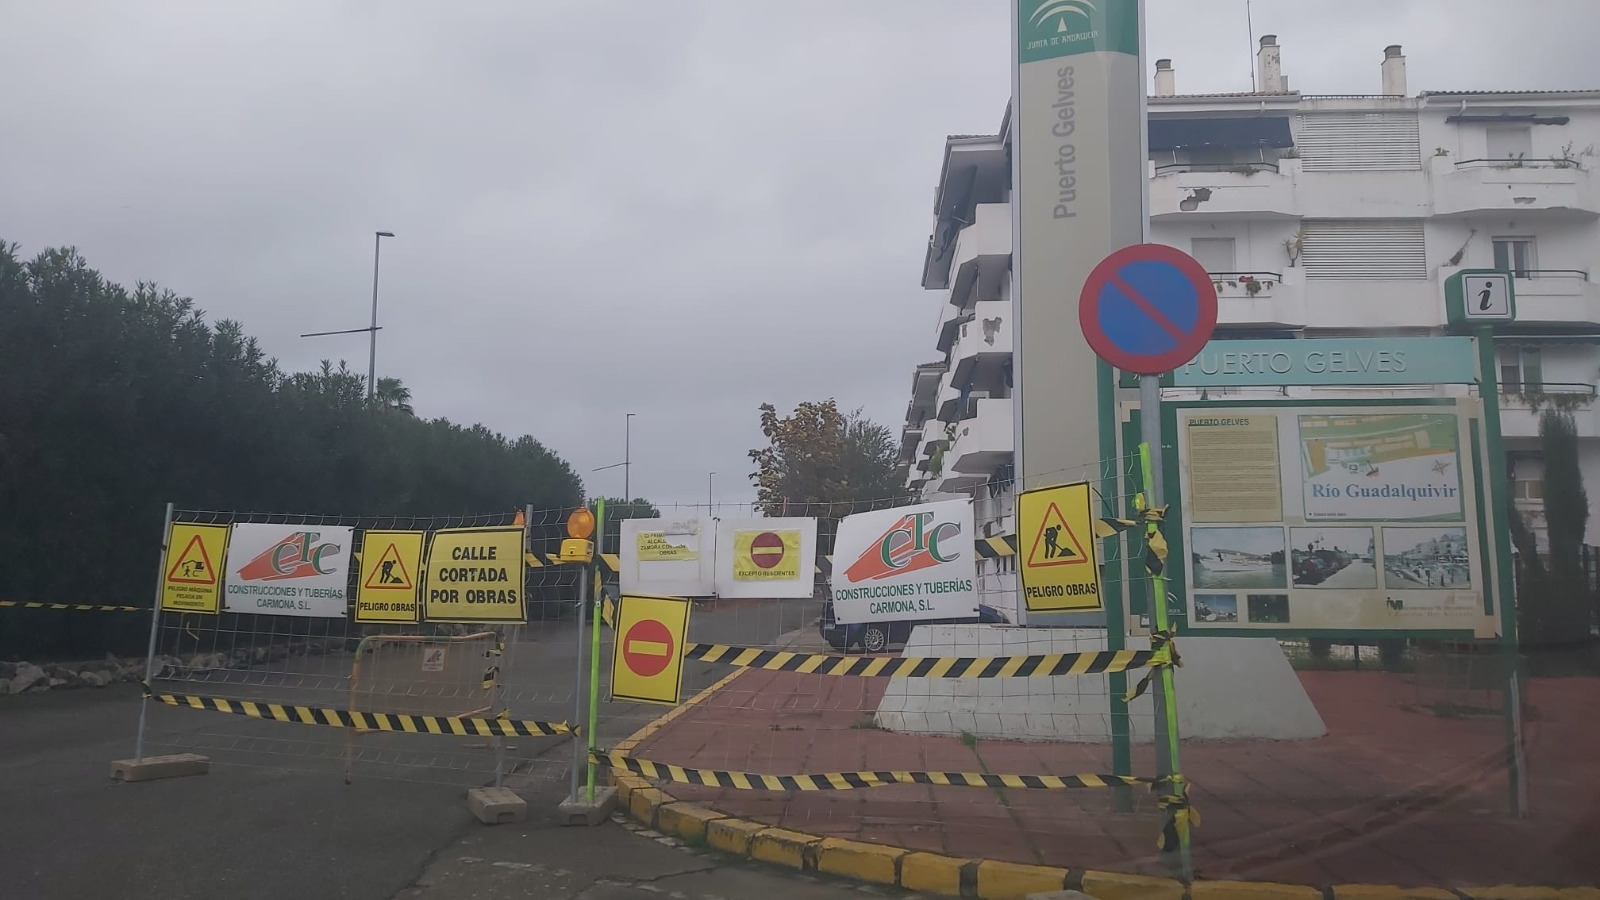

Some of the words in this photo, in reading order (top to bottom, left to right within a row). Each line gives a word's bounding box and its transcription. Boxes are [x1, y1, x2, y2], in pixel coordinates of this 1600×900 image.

[1027, 39, 1048, 49] JUNTA
[1051, 37, 1059, 46] DE
[1052, 66, 1075, 137] Gelves
[1053, 144, 1077, 220] Puerto
[1184, 352, 1292, 375] PUERTO
[1304, 351, 1407, 373] GELVES
[1189, 418, 1219, 426] PUERTO
[1221, 418, 1250, 426] GELVES
[1313, 484, 1341, 499] Río
[1345, 483, 1457, 501] Guadalquivir
[452, 546, 497, 560] CALLE
[439, 568, 508, 582] CORTADA
[228, 584, 296, 597] CONSTRUCCIONES
[298, 588, 303, 597] Y
[304, 587, 343, 599] TUBERÍAS
[835, 584, 914, 601] CONSTRUCCIONES
[917, 584, 922, 593] Y
[923, 577, 973, 592] TUBERÍAS
[1027, 586, 1064, 598] PELIGRO
[1065, 582, 1097, 596] OBRAS
[430, 590, 459, 604] POR
[466, 590, 517, 604] OBRAS
[360, 602, 389, 611] PELIGRO
[391, 603, 415, 611] OBRAS
[869, 599, 917, 615] CARMONA,
[918, 600, 935, 611] S.L.
